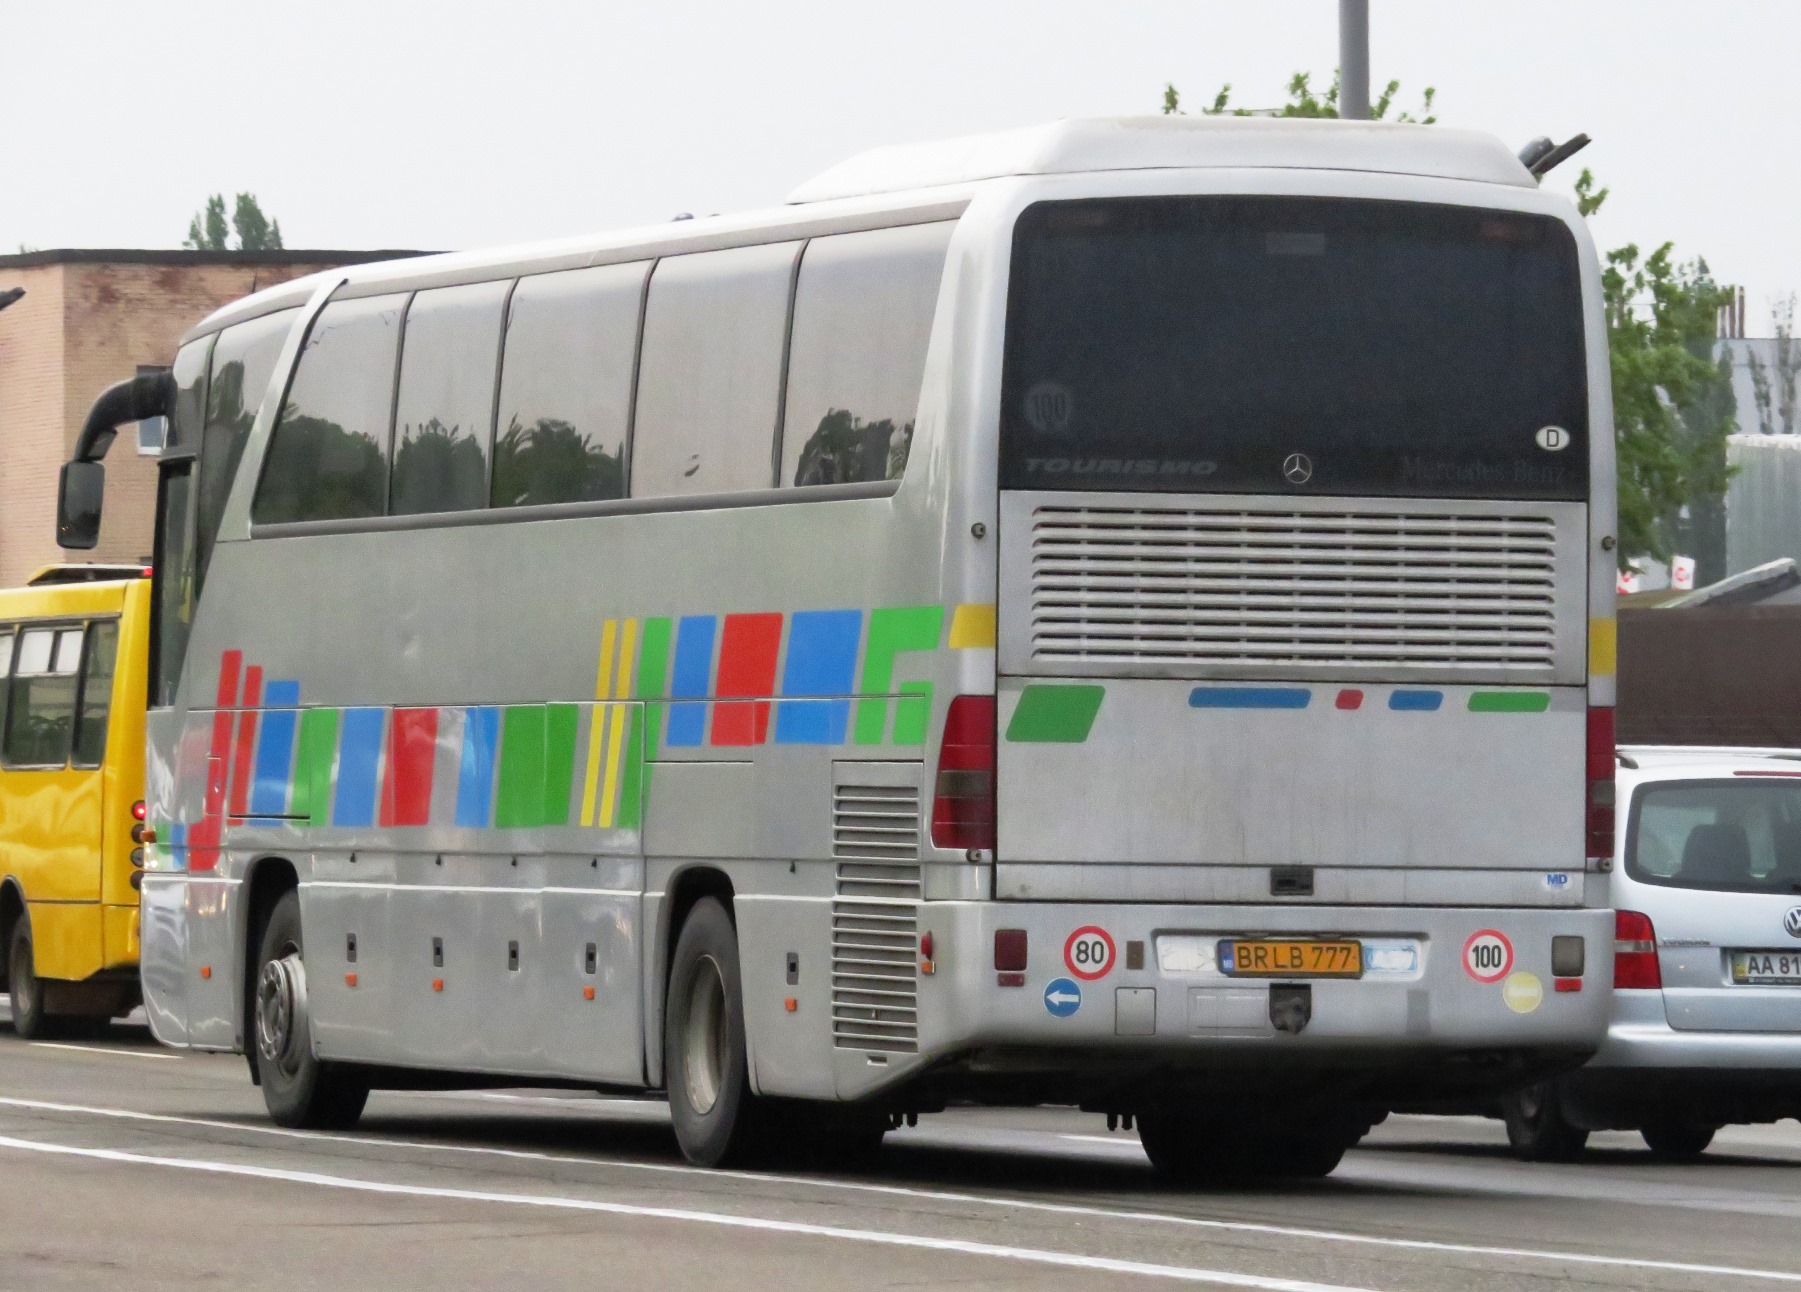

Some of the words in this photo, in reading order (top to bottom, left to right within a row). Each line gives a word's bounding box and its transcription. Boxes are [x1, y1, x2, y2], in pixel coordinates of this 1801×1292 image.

[1546, 429, 1559, 447] D
[1026, 458, 1218, 475] TOURISMO
[1076, 940, 1105, 964] 80
[1311, 946, 1351, 969] 777
[1472, 944, 1502, 968] 100
[1748, 955, 1775, 975] AA
